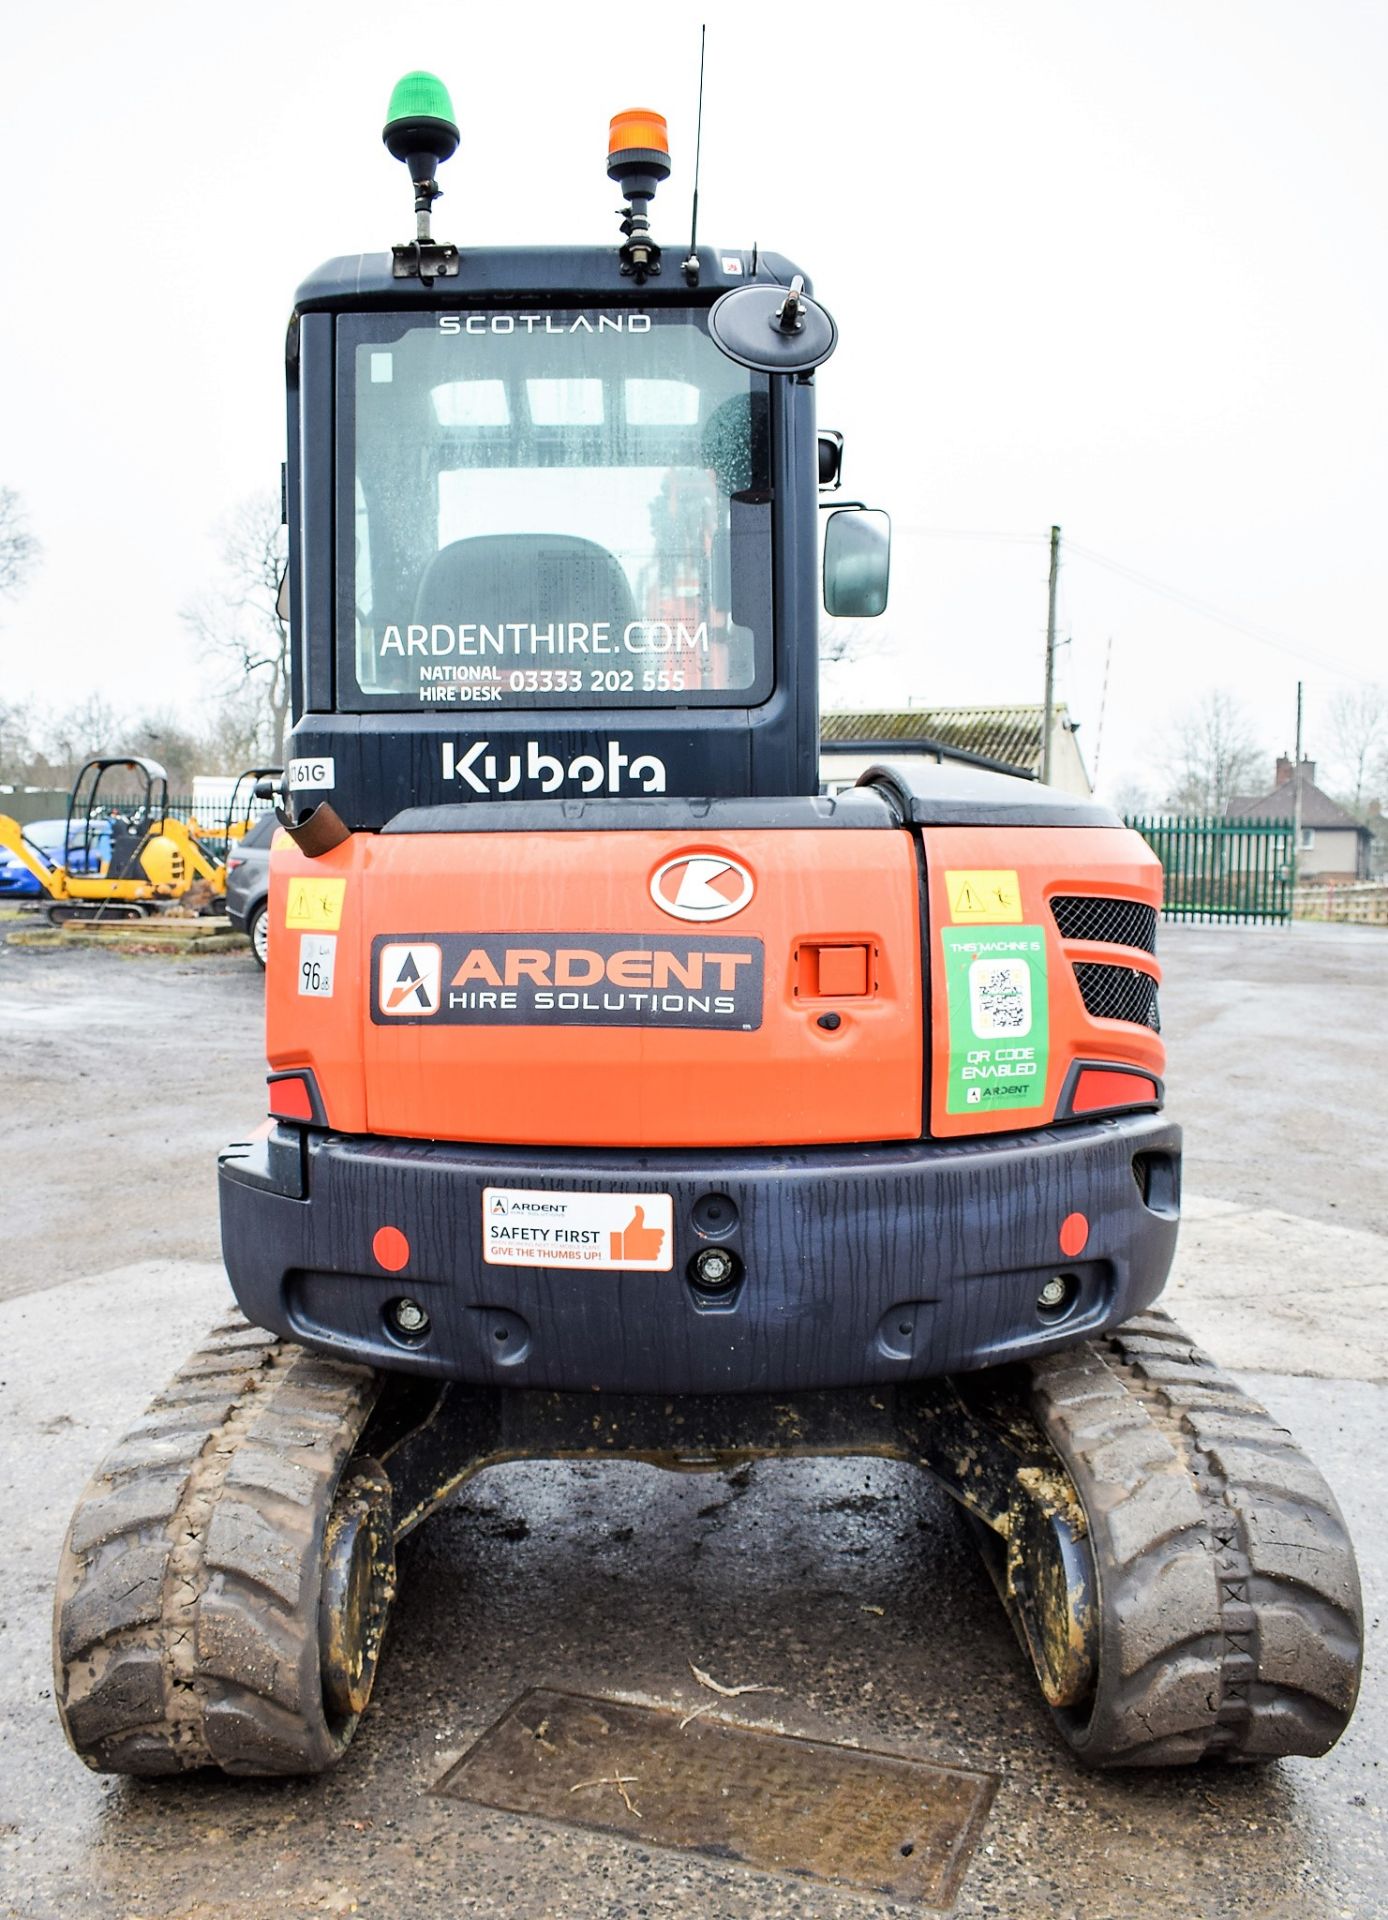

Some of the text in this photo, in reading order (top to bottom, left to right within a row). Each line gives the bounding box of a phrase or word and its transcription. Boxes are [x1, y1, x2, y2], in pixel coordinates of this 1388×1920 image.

[439, 314, 651, 335] SCOTLAND
[379, 621, 710, 657] ARDENTHIRE.COM
[419, 665, 502, 682] NATIONAL
[508, 669, 686, 693] 03333 202 555
[419, 685, 502, 702] HIRE DESK
[442, 741, 666, 793] Kubota
[950, 942, 977, 953] THIS
[980, 941, 1029, 952] MACHINE
[302, 961, 321, 991] 96
[450, 948, 752, 991] ARDENT
[449, 992, 735, 1015] HIRE SOLUTIONS
[966, 1047, 1035, 1065] QR CODE
[961, 1062, 1037, 1080] ENABLED
[982, 1084, 1030, 1097] ARDENT
[511, 1202, 568, 1213] ARDENT
[490, 1225, 600, 1244] SAFETY FIRST
[490, 1246, 602, 1261] GIVE THE THUMBS UP!
